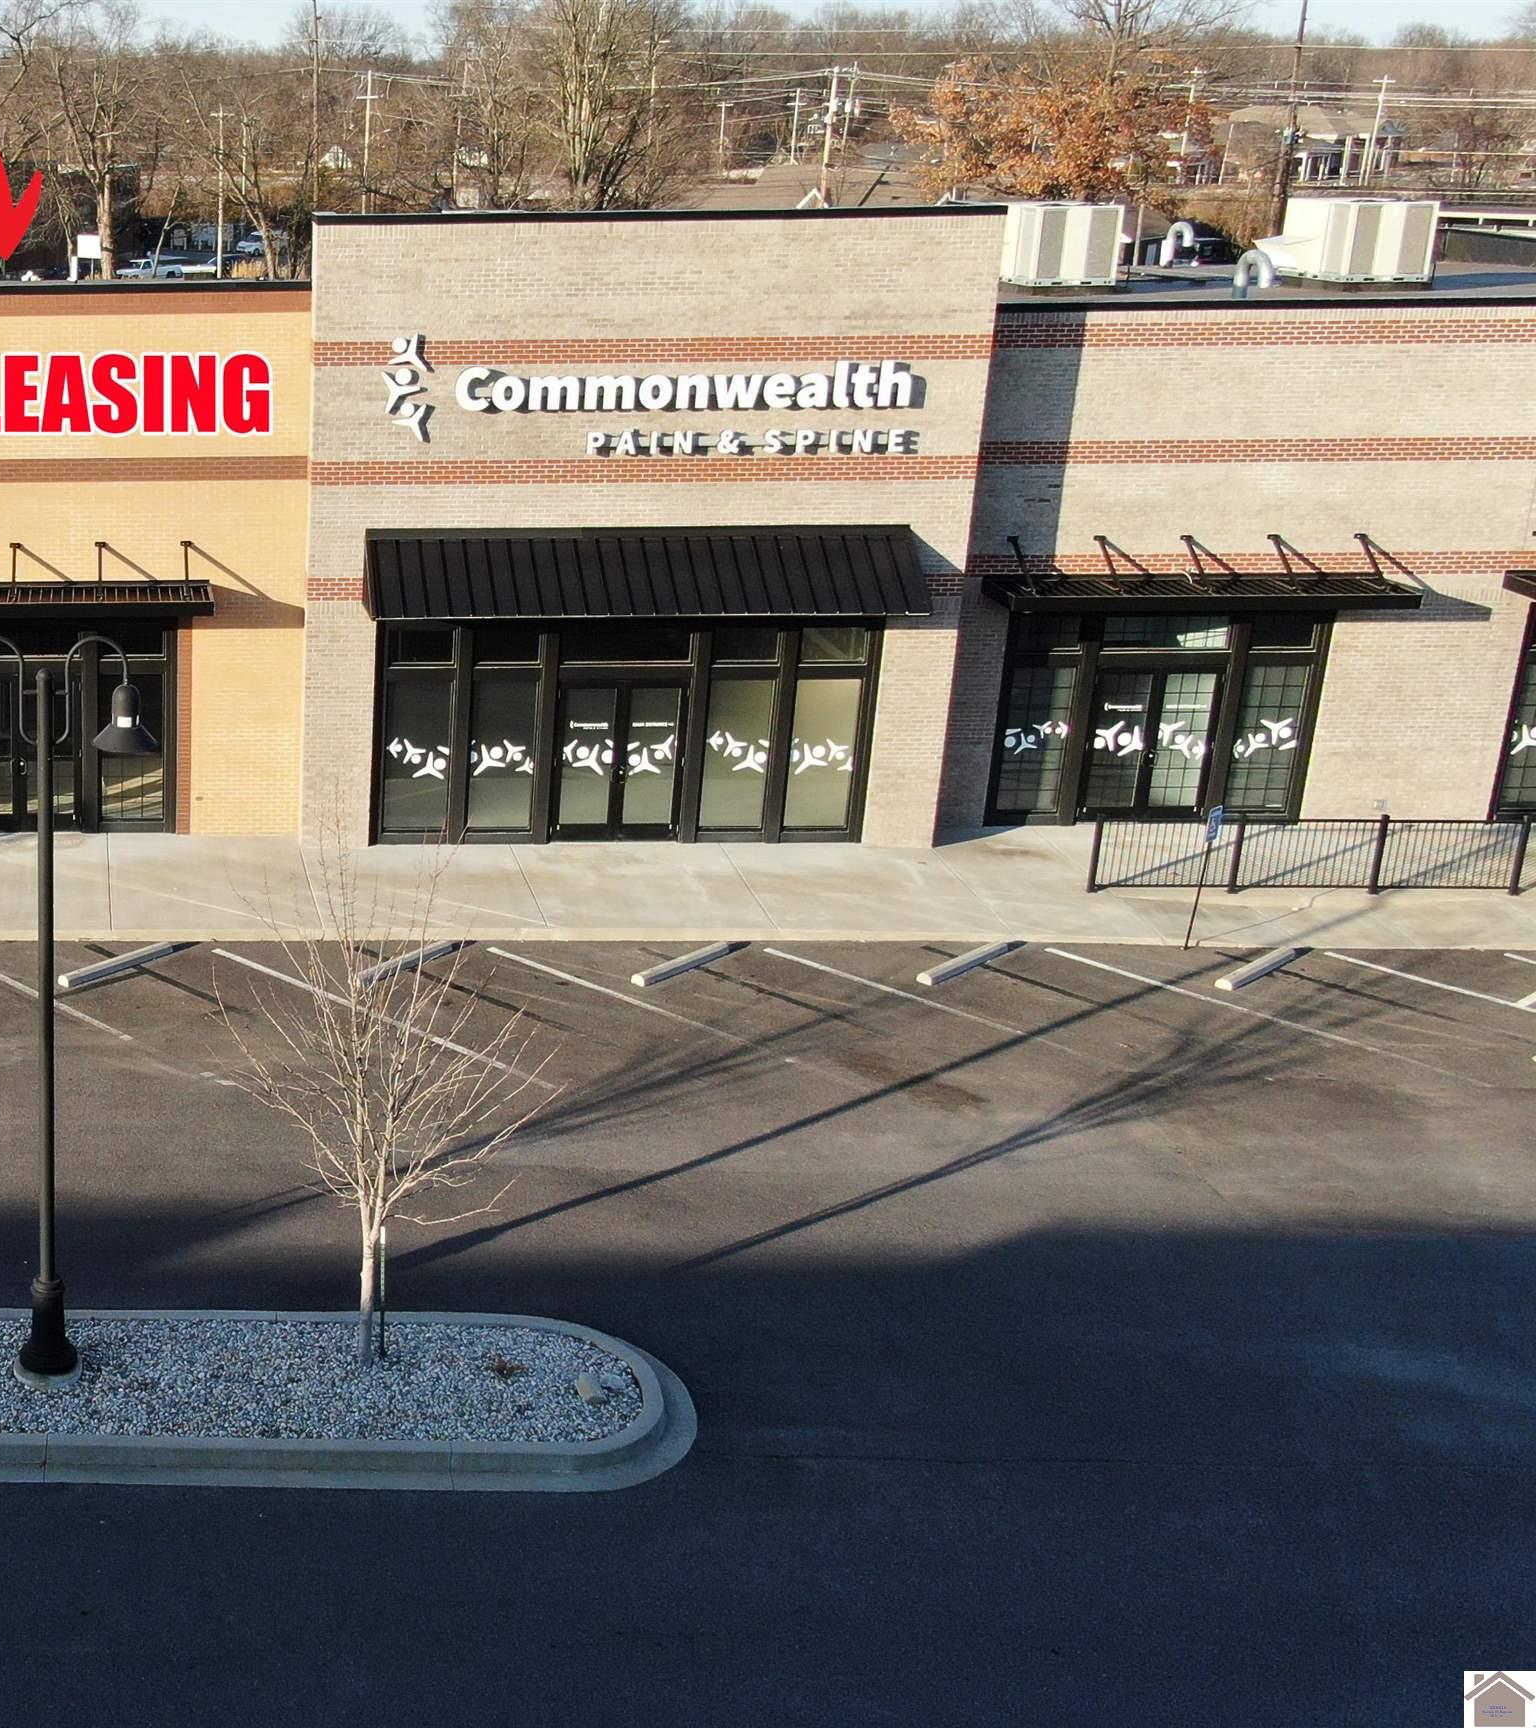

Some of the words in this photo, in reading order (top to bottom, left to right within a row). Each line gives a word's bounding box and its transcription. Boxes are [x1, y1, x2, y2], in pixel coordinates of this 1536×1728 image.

[454, 360, 912, 412] Commonwealth
[586, 430, 695, 455] PAIN
[717, 430, 741, 453] &
[763, 428, 911, 453] SPINE
